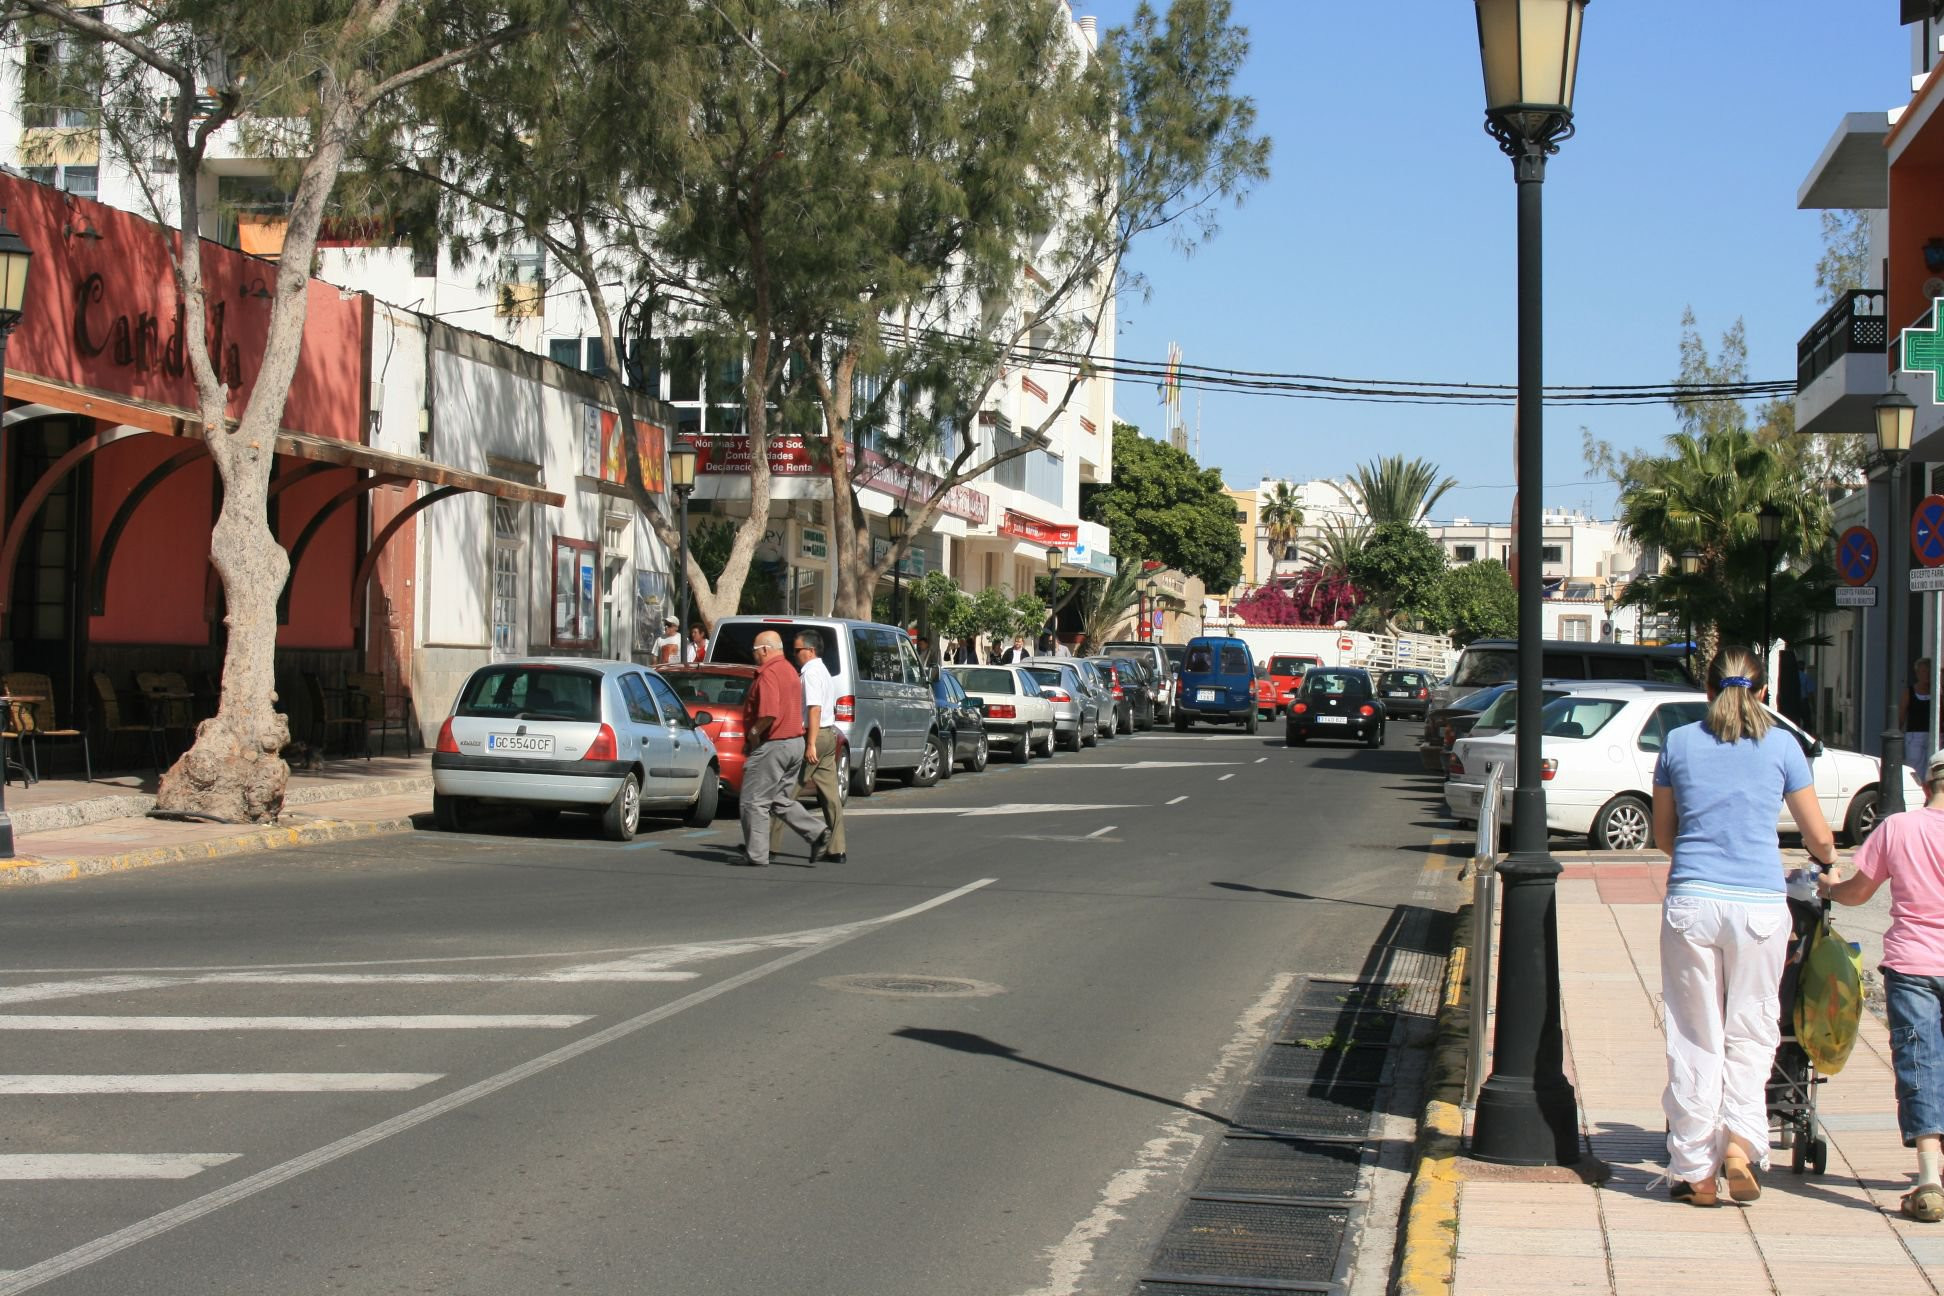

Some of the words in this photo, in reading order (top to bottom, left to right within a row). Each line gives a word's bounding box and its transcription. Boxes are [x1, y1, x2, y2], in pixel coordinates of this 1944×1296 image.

[73, 272, 243, 390] Candla
[695, 439, 735, 448] Nómnas
[737, 441, 743, 450] y
[725, 451, 794, 460] Contadades
[772, 463, 784, 472] de
[786, 463, 813, 472] Renta
[1931, 568, 1944, 578] FARM
[495, 737, 508, 748] GC
[510, 737, 536, 750] 5540
[537, 739, 551, 750] CF
